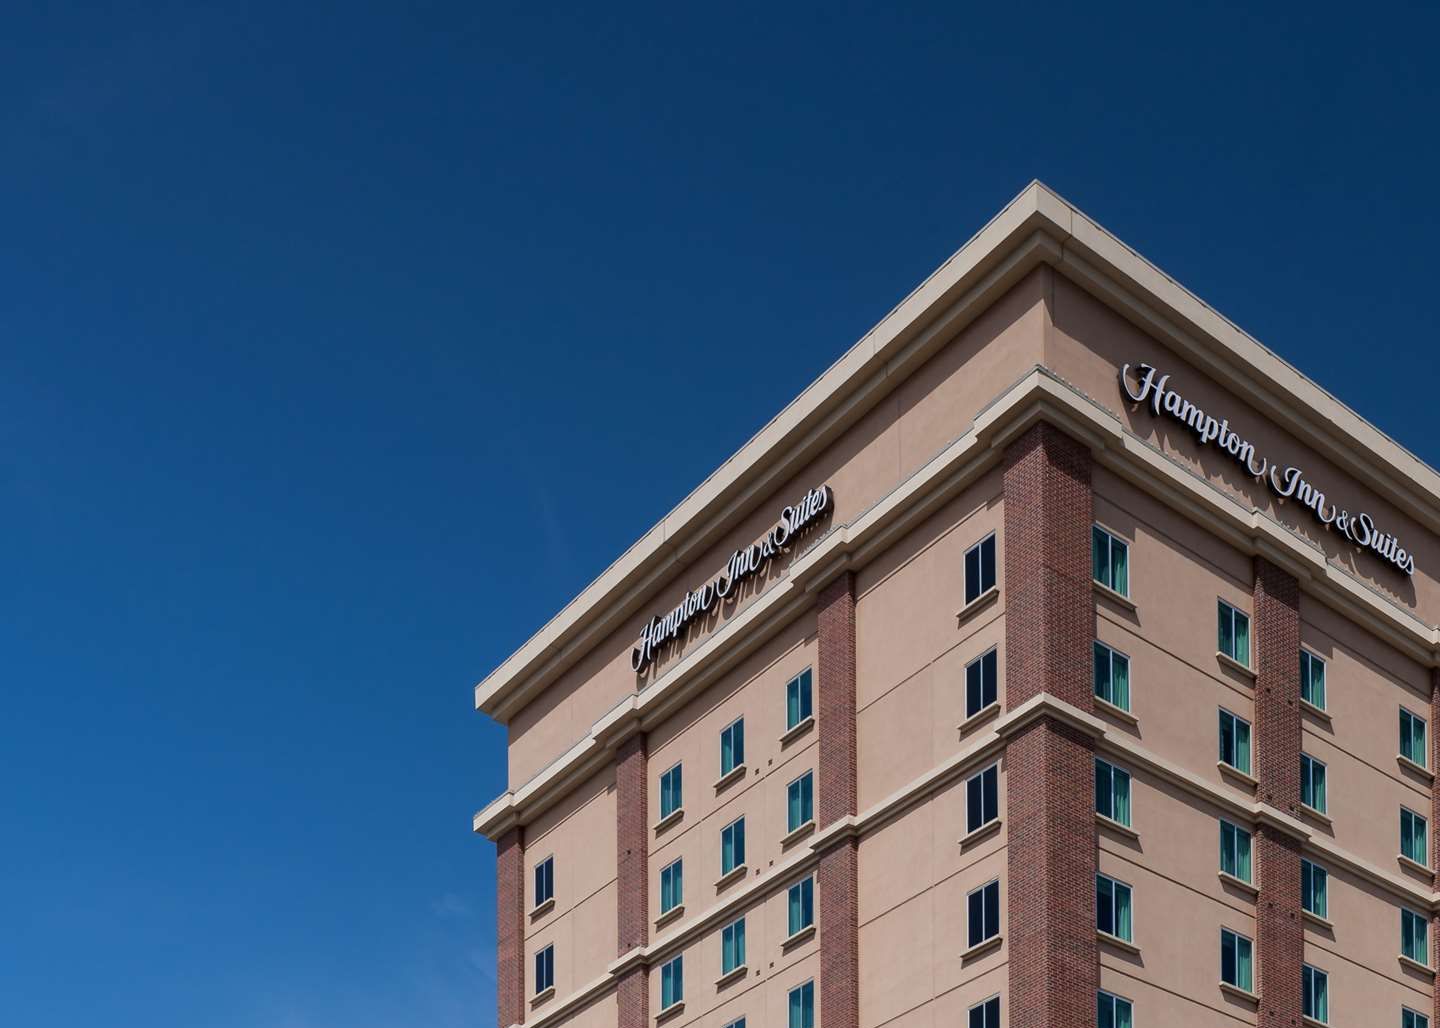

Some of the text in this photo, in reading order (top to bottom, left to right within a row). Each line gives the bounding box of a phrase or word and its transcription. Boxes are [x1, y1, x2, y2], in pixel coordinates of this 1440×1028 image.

[1119, 363, 1416, 575] Hampton Inn & Suites
[632, 581, 715, 672] Hampton
[715, 542, 764, 597] Inn
[774, 485, 829, 546] Suites
